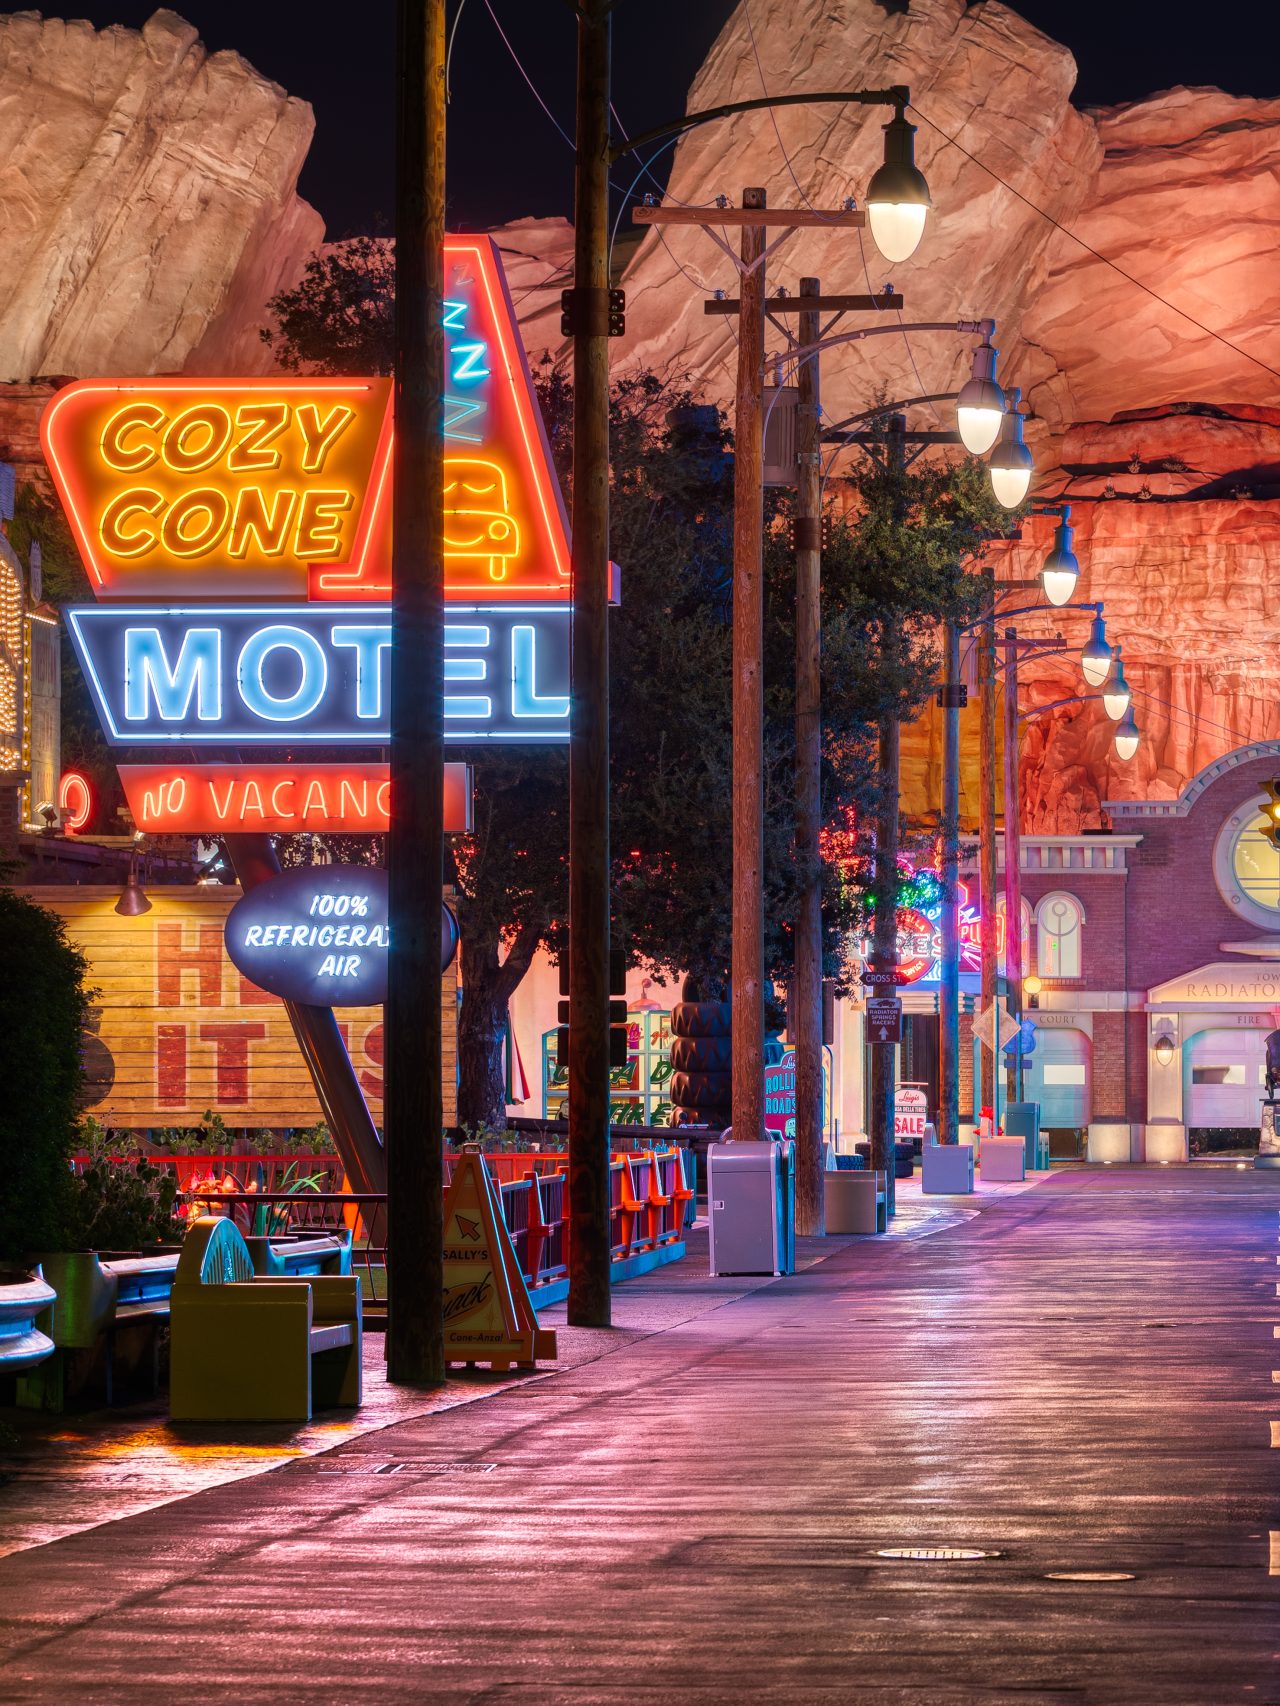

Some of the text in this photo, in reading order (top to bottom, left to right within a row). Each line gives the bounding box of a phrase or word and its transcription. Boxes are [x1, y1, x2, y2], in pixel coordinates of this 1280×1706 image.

[100, 402, 356, 473] COZY
[100, 486, 354, 558] CONE
[124, 624, 572, 722] MOTEL
[143, 777, 391, 822] NO VACANC
[309, 895, 369, 917] 100%
[245, 925, 390, 948] REFRIGERA
[318, 955, 361, 977] AIR
[866, 975, 891, 983] CROSS
[1039, 1015, 1077, 1024] COURT
[1237, 1015, 1261, 1024] FIRE
[157, 1022, 267, 1108] IT
[895, 1117, 924, 1134] SALE
[442, 1249, 489, 1260] SALLY'S
